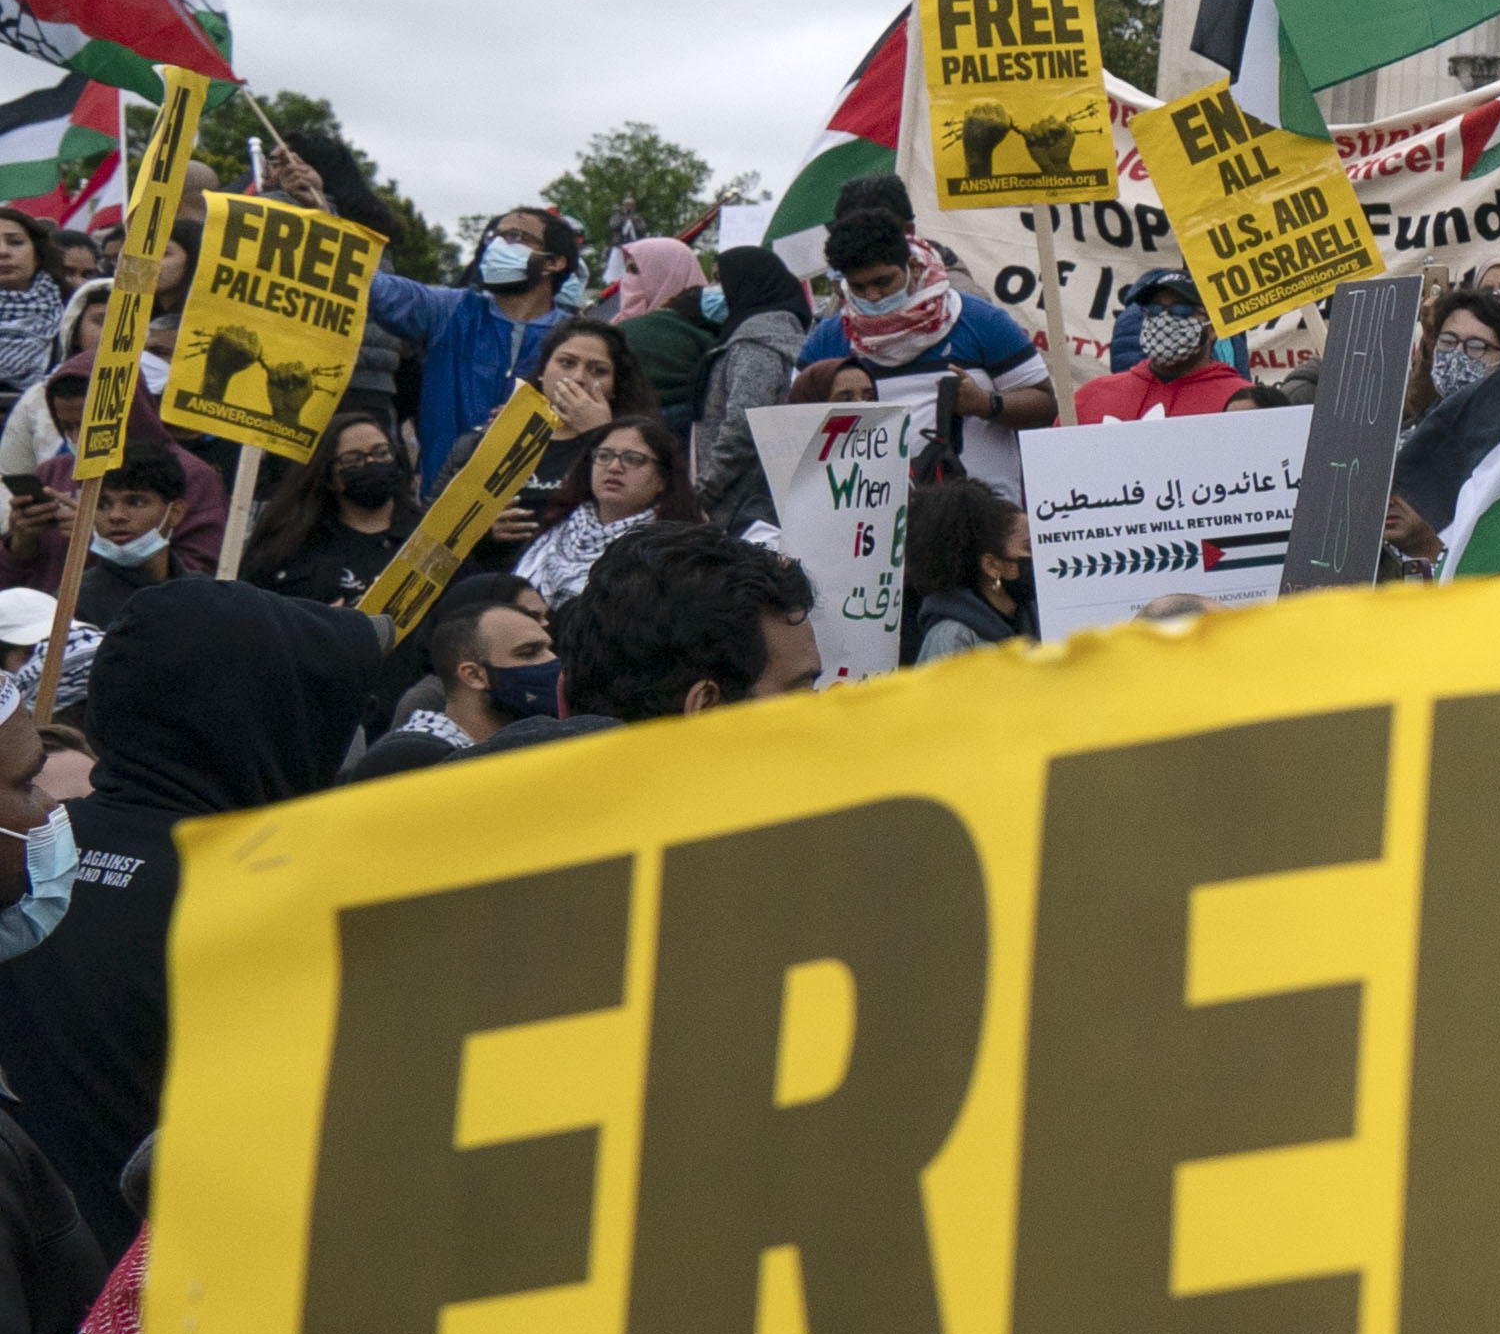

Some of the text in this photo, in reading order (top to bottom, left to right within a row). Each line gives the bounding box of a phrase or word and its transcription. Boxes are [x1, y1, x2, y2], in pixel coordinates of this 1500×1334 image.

[941, 50, 1088, 85] PALESTINE
[959, 170, 1097, 194] ANSWERcoalition.org
[1217, 146, 1281, 197] ALL
[1206, 186, 1329, 261] U.S. AID
[220, 199, 370, 302] FREE
[1208, 218, 1363, 304] TO ISRAEL!
[211, 264, 356, 337] PALESTINE
[1231, 258, 1361, 319] ANSWERcoalition.org
[818, 415, 888, 462] There
[826, 463, 890, 510] When
[1036, 480, 1146, 522] فلسطين
[1155, 479, 1186, 512] إلى
[1192, 473, 1276, 507] عائدون
[854, 522, 875, 558] is
[1037, 511, 1264, 545] INEVITABLY WE WILL RETURN TO
[81, 849, 146, 873] AGAINST
[101, 871, 133, 889] WAR
